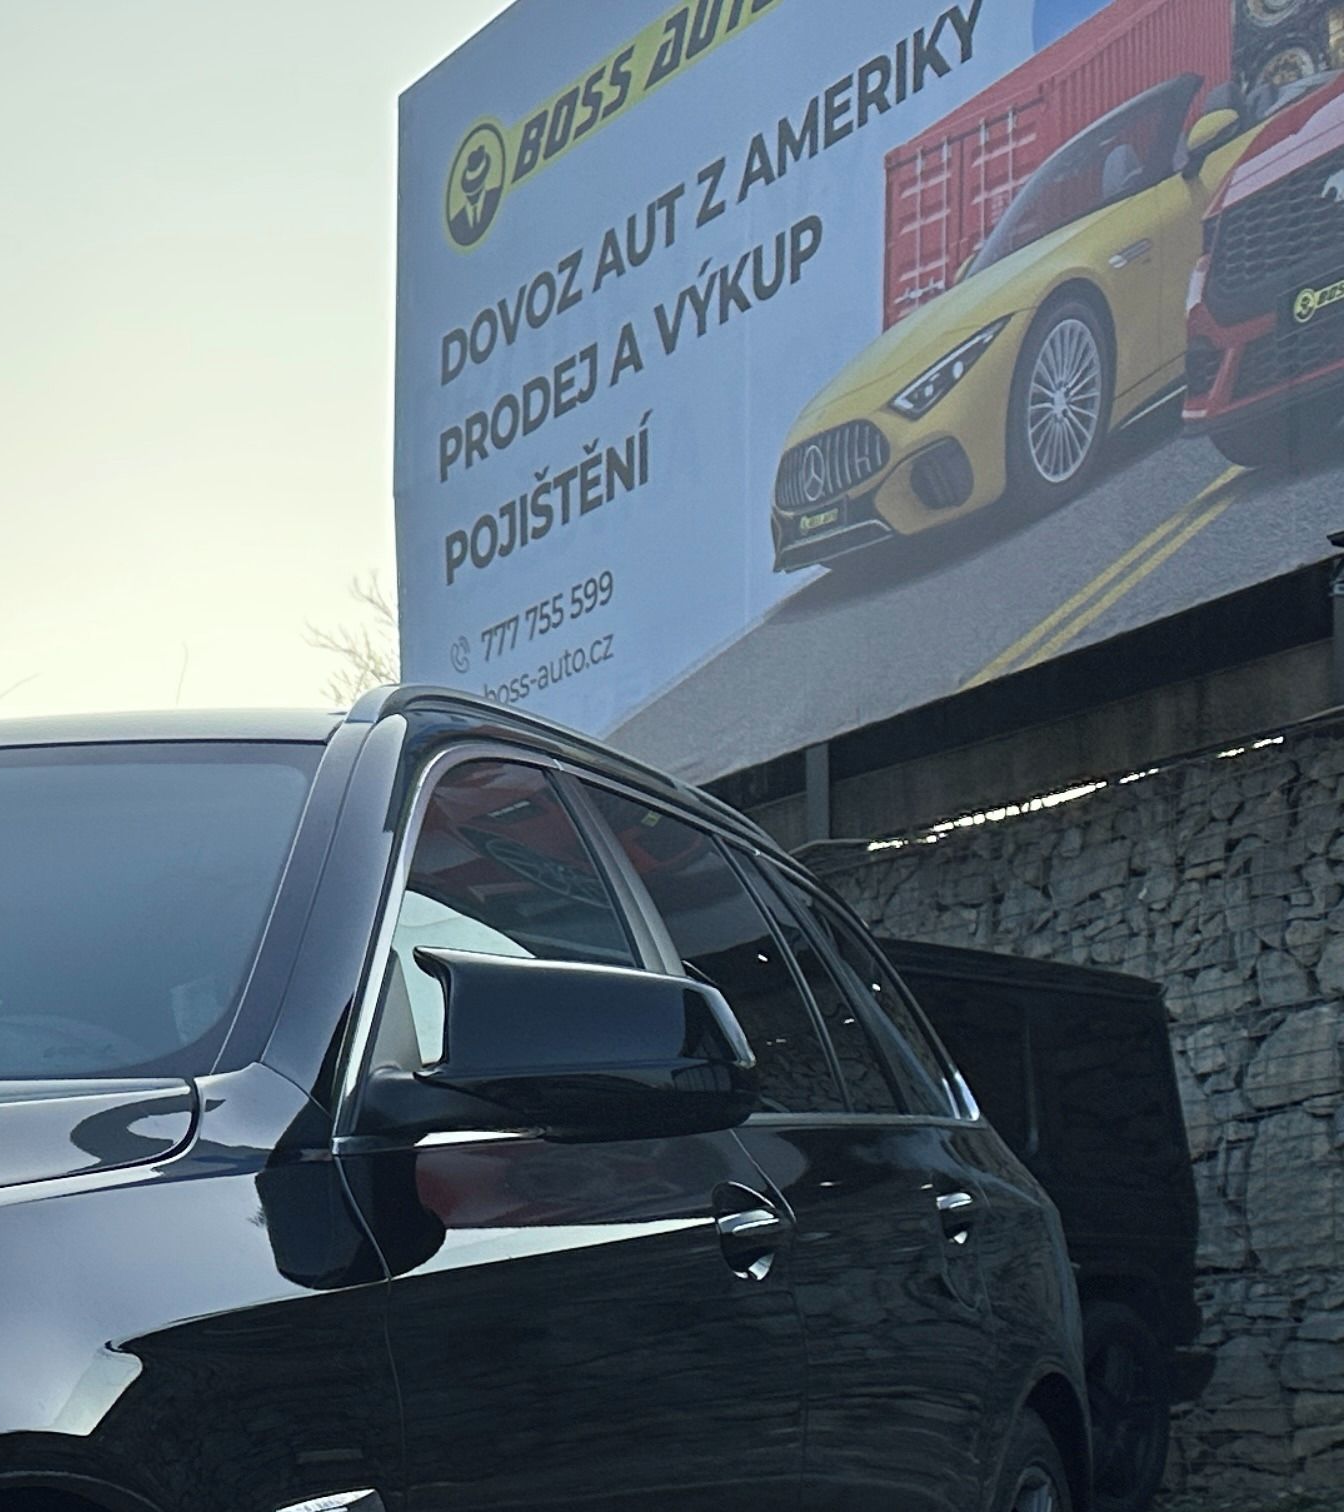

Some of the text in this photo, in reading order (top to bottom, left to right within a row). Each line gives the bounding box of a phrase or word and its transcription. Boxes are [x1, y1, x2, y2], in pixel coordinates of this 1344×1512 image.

[511, 0, 773, 184] BOSS AU
[441, 0, 982, 386] DOVOZ AUT Z AMERIKY
[440, 214, 823, 483] PRODEJ A VÝKUP
[445, 408, 653, 586] POJIŠTĚNÍ
[481, 570, 613, 662] 777 755 599
